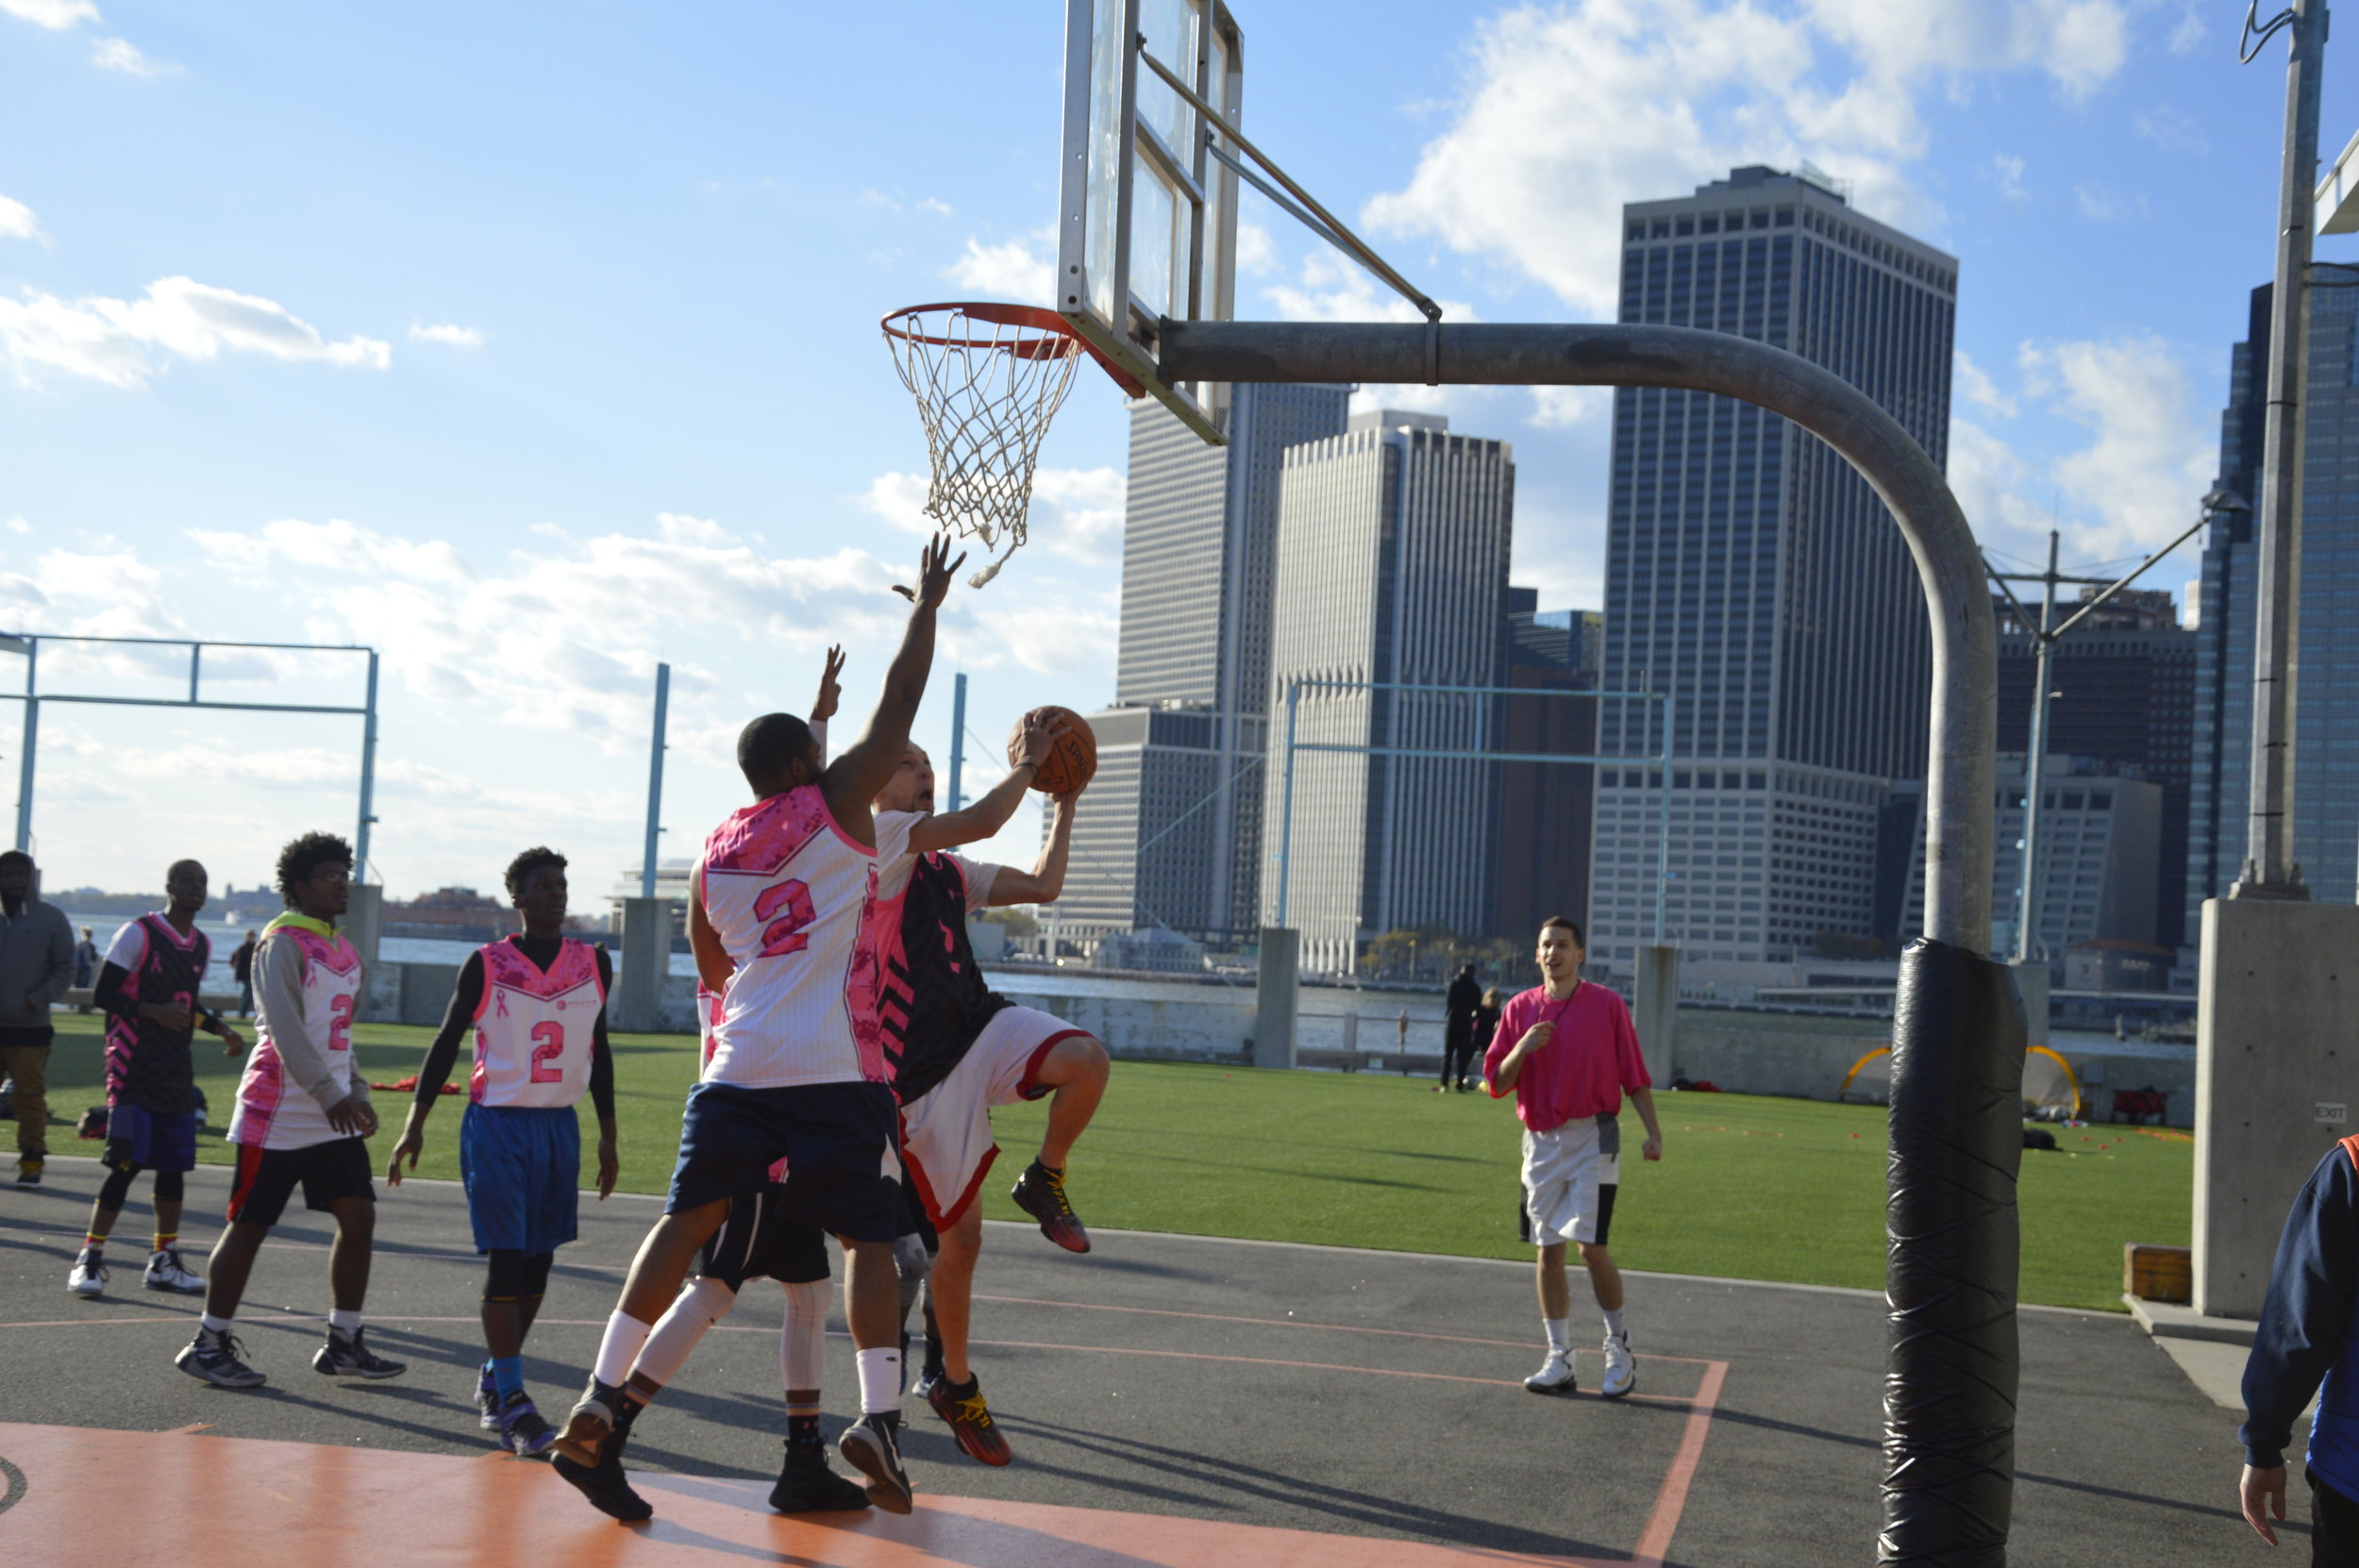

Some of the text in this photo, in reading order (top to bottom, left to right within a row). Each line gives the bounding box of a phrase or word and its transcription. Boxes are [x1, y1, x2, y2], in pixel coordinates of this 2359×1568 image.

[753, 878, 816, 959] 2
[328, 993, 354, 1051] 2
[530, 1021, 564, 1083] 2
[2316, 1106, 2345, 1119] EXIT
